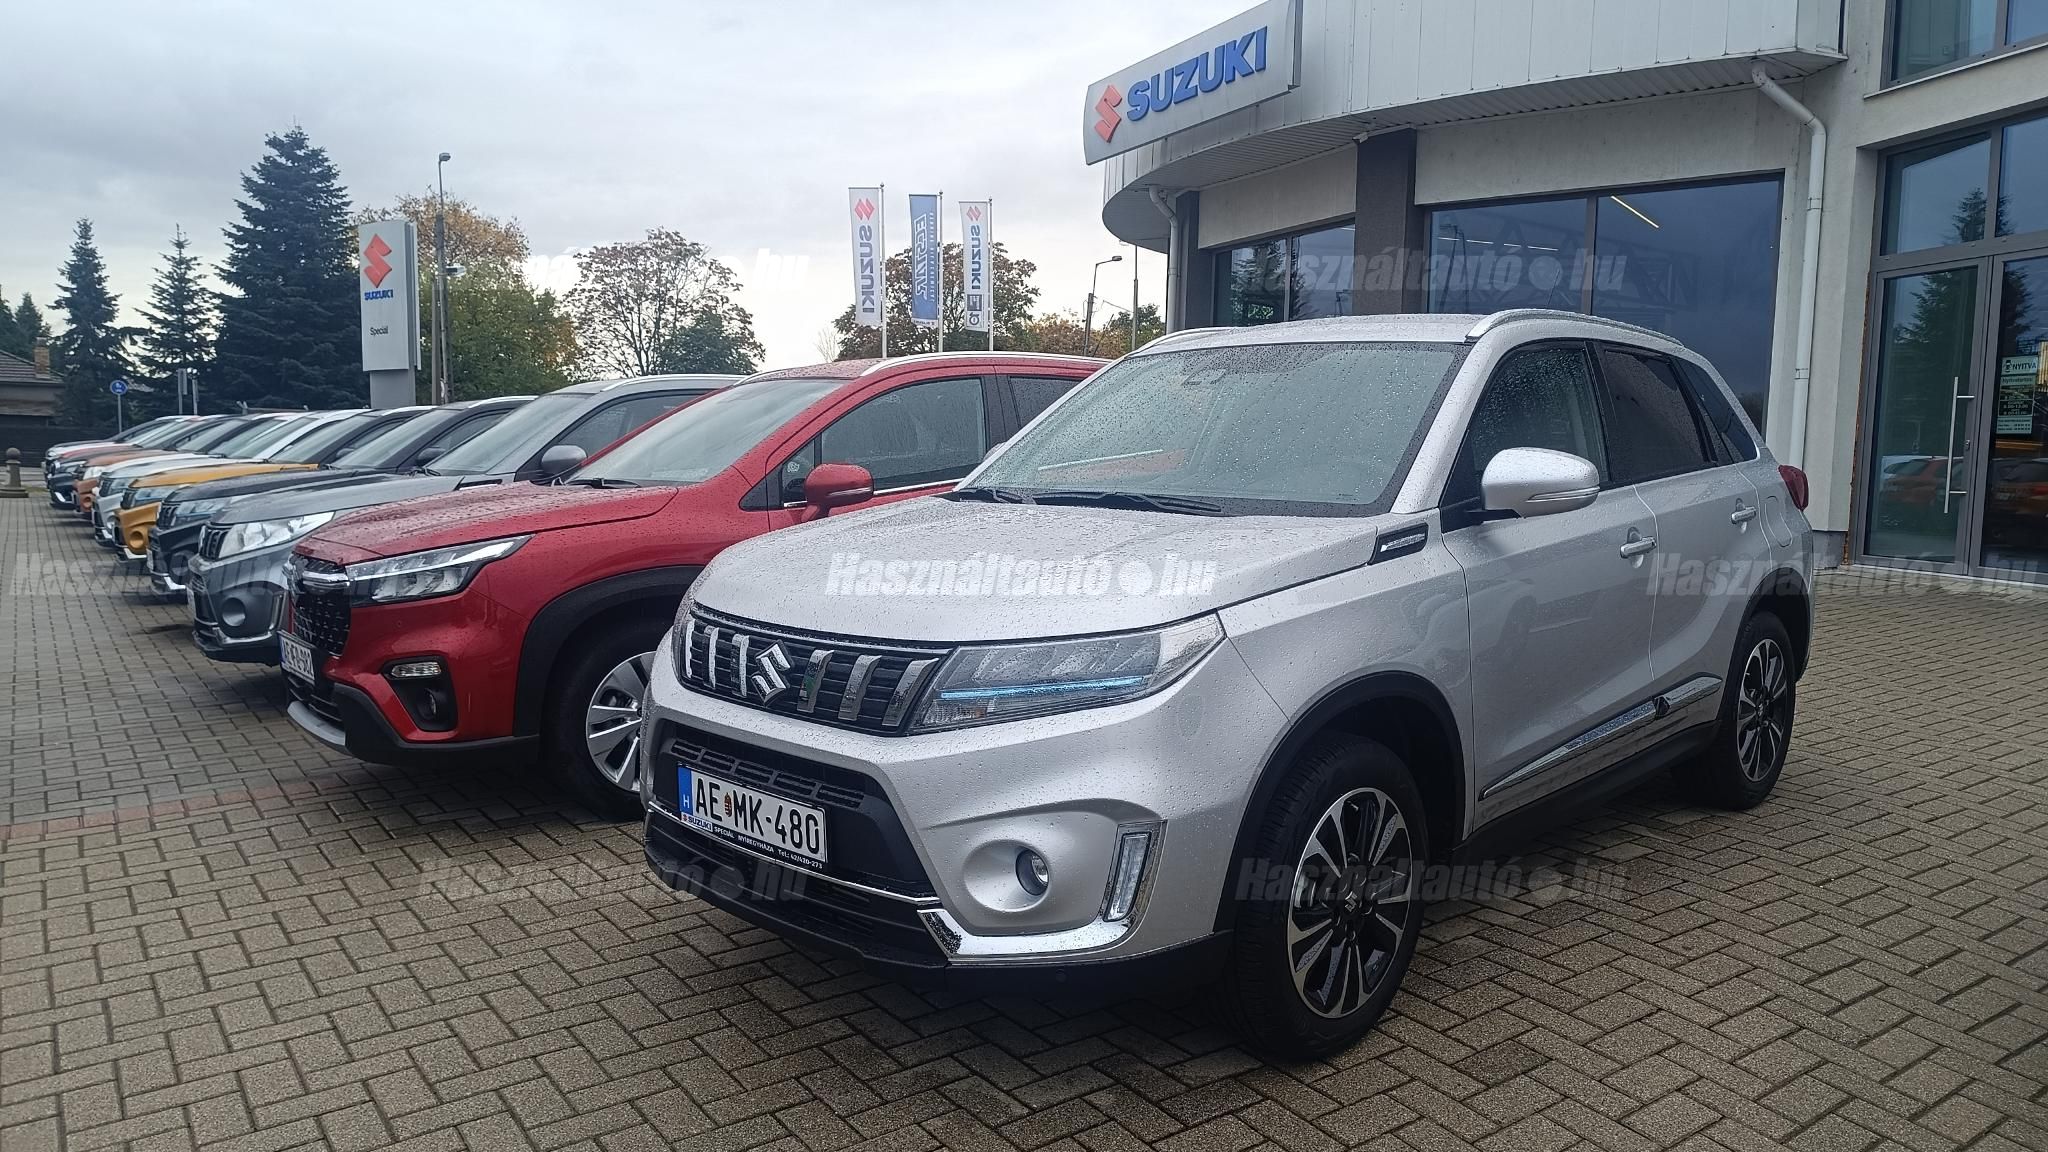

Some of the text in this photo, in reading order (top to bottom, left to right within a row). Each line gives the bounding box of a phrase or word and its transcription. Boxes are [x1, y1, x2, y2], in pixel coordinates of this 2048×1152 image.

[1126, 26, 1268, 122] SUZUKI
[364, 289, 394, 301] SUZUKI
[2012, 362, 2037, 371] NYITVA
[682, 794, 691, 809] H
[688, 815, 711, 829] SUZUKI
[695, 778, 820, 855] AE MK-480
